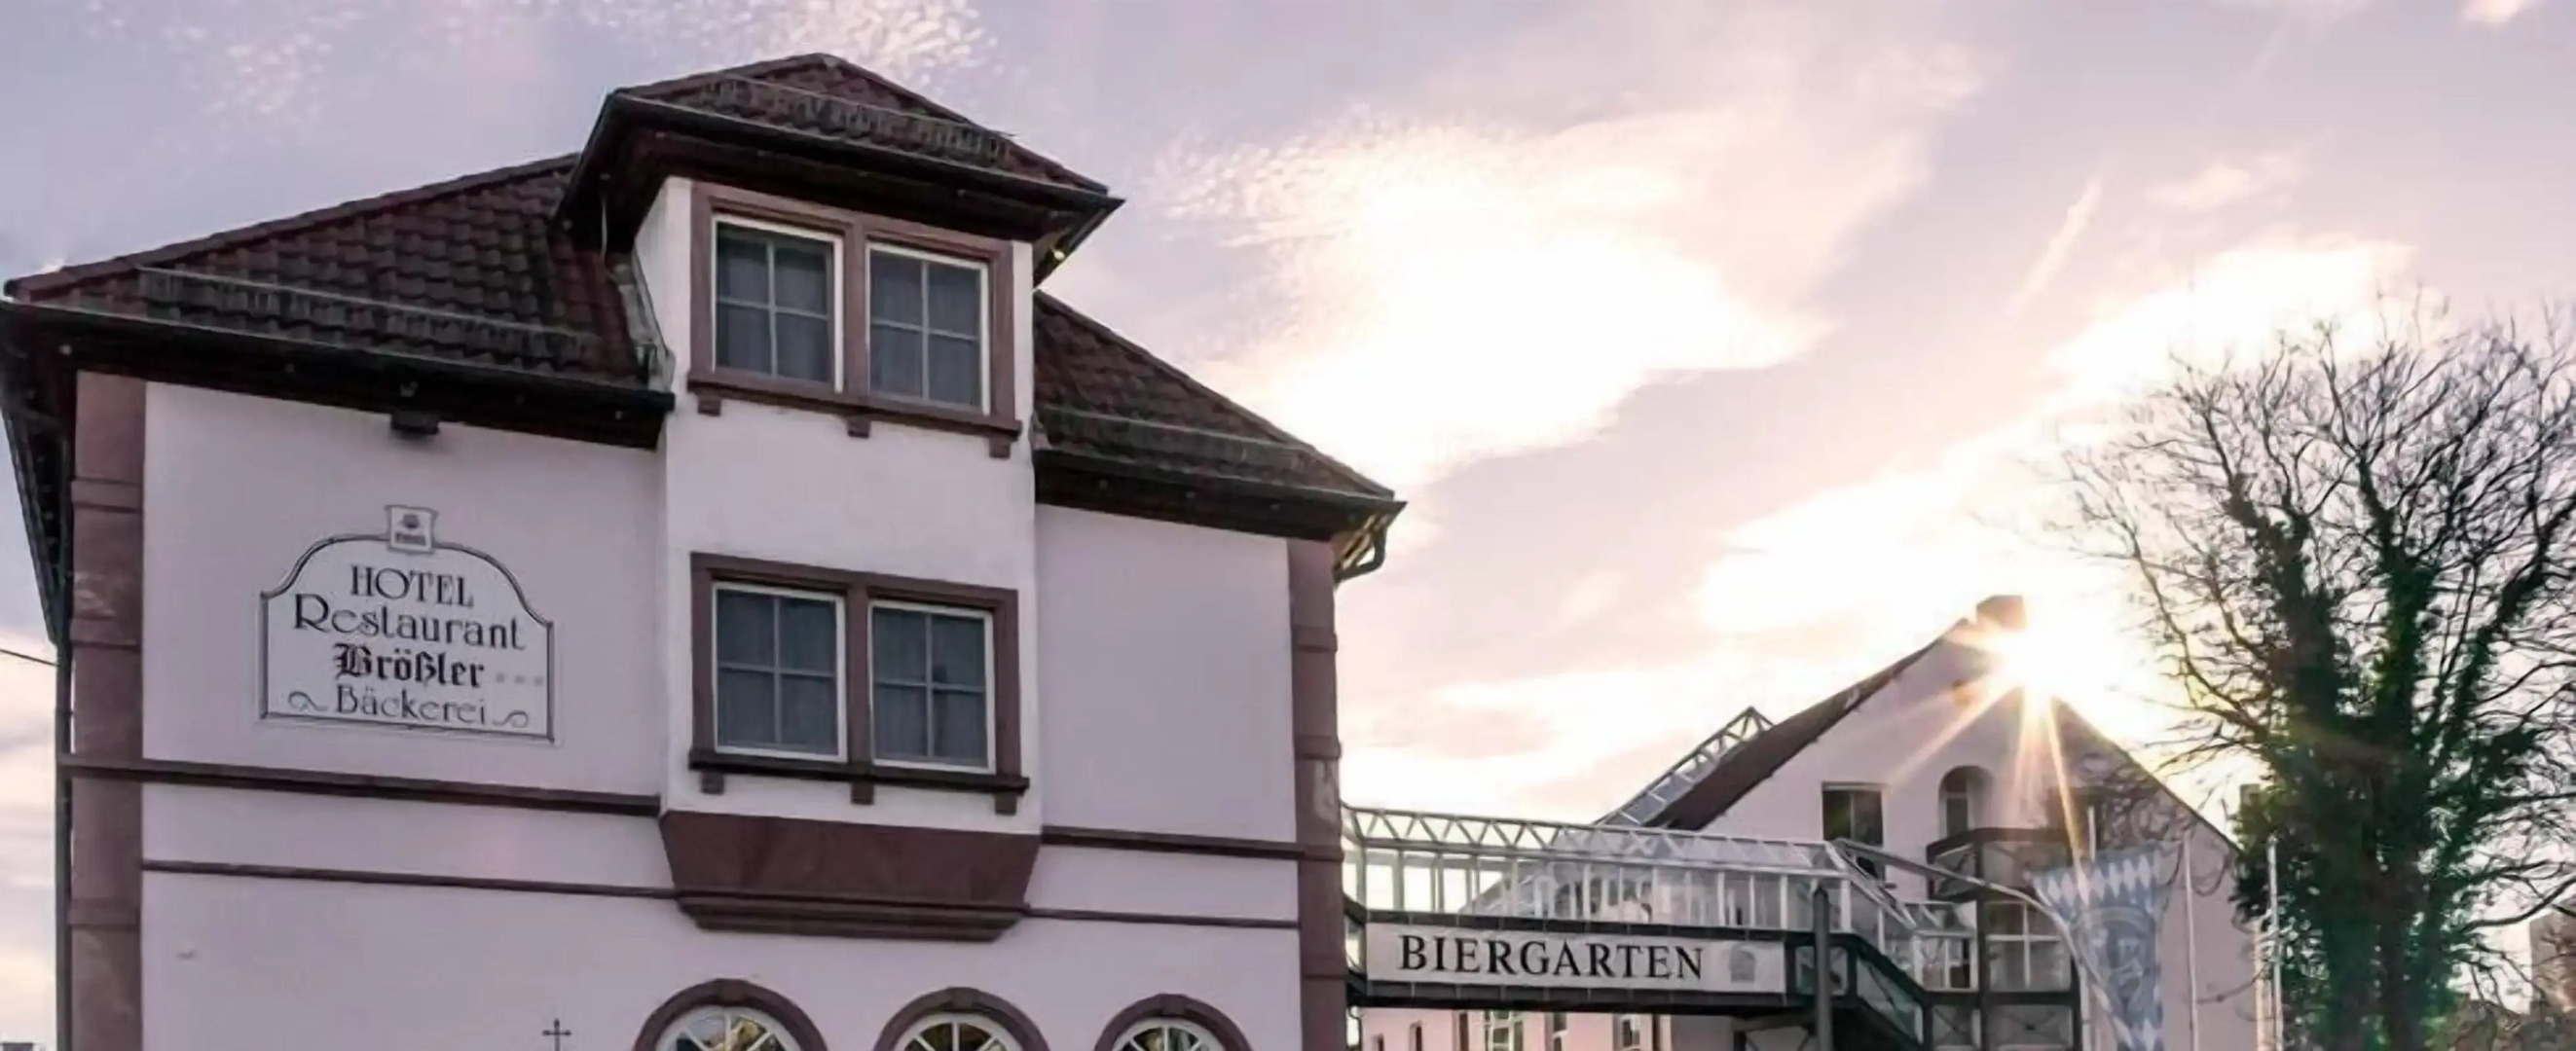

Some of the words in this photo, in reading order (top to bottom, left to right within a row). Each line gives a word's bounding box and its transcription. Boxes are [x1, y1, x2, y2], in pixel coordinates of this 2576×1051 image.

[350, 564, 474, 607] HOTEL
[293, 593, 527, 651] Restaurant
[333, 642, 485, 688] Brößler
[335, 684, 485, 725] Bäckerei
[1399, 934, 1704, 980] BIERGARTEN
